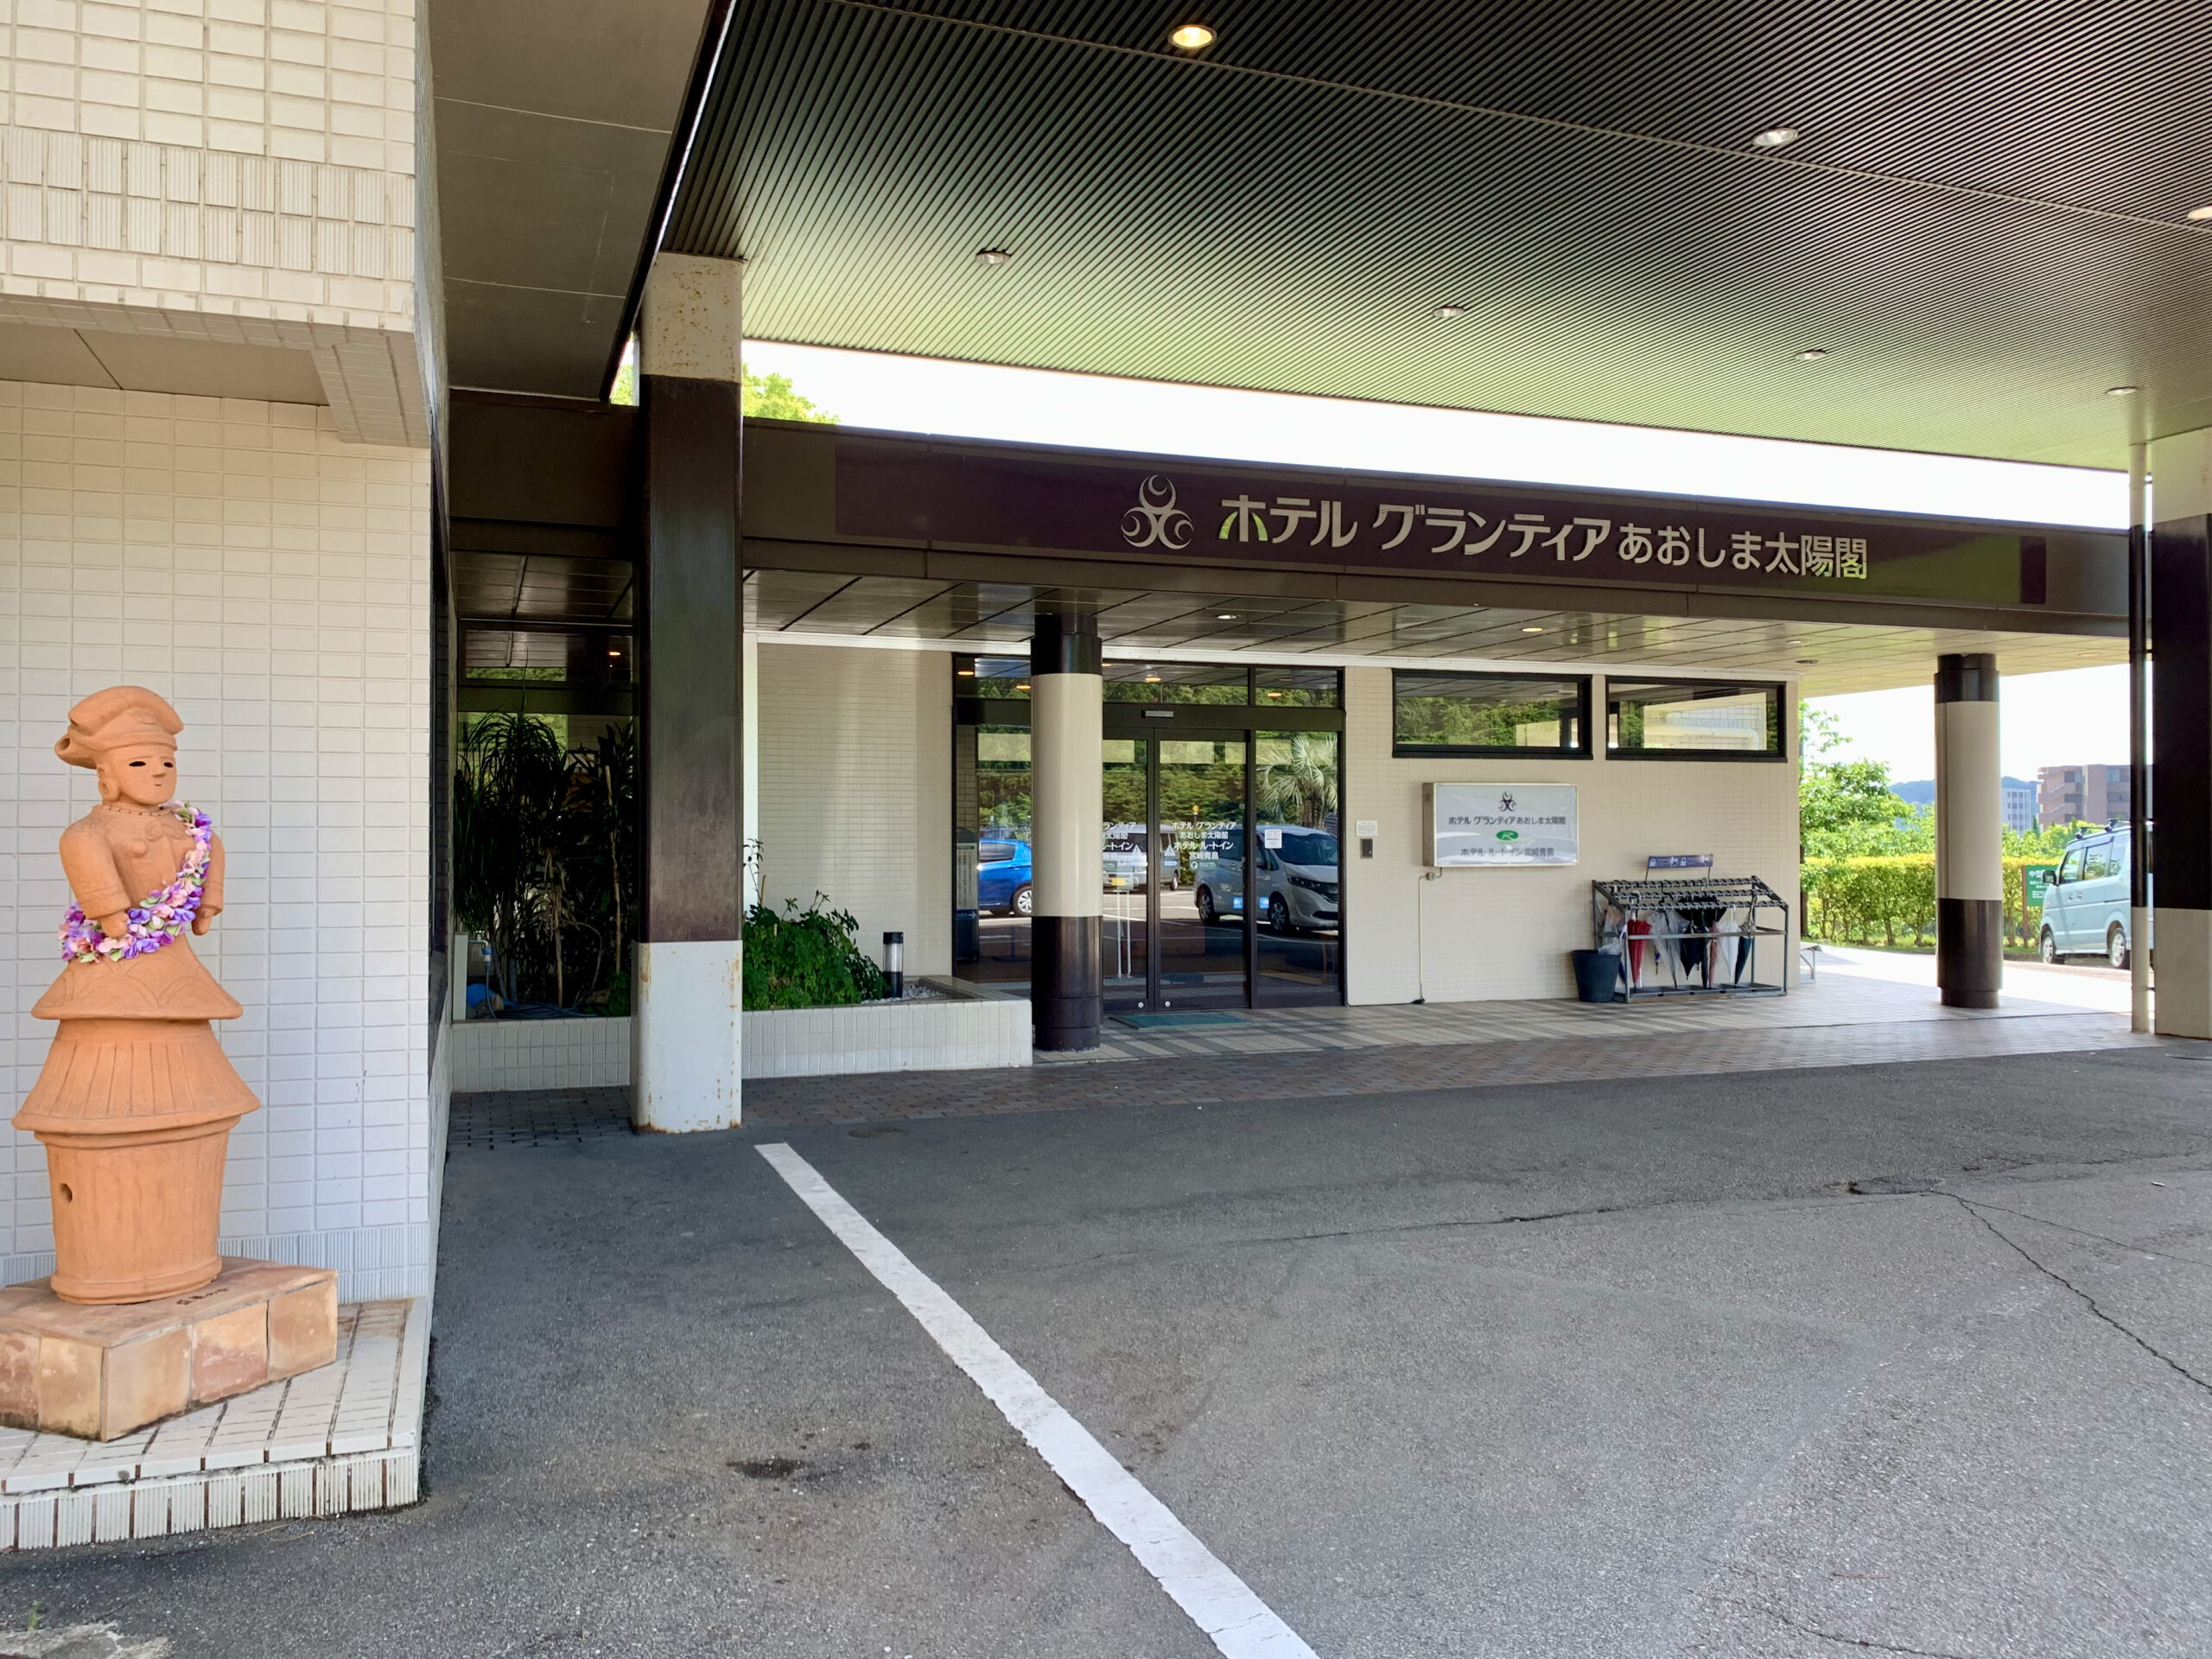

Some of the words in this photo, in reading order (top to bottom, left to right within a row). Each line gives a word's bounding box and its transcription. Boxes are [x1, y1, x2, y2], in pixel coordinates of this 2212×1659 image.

[1219, 494, 1358, 548] ホテル
[1448, 817, 1471, 825] ホテル
[1173, 842, 1197, 850] ホテル
[1200, 842, 1234, 850] ルートイン
